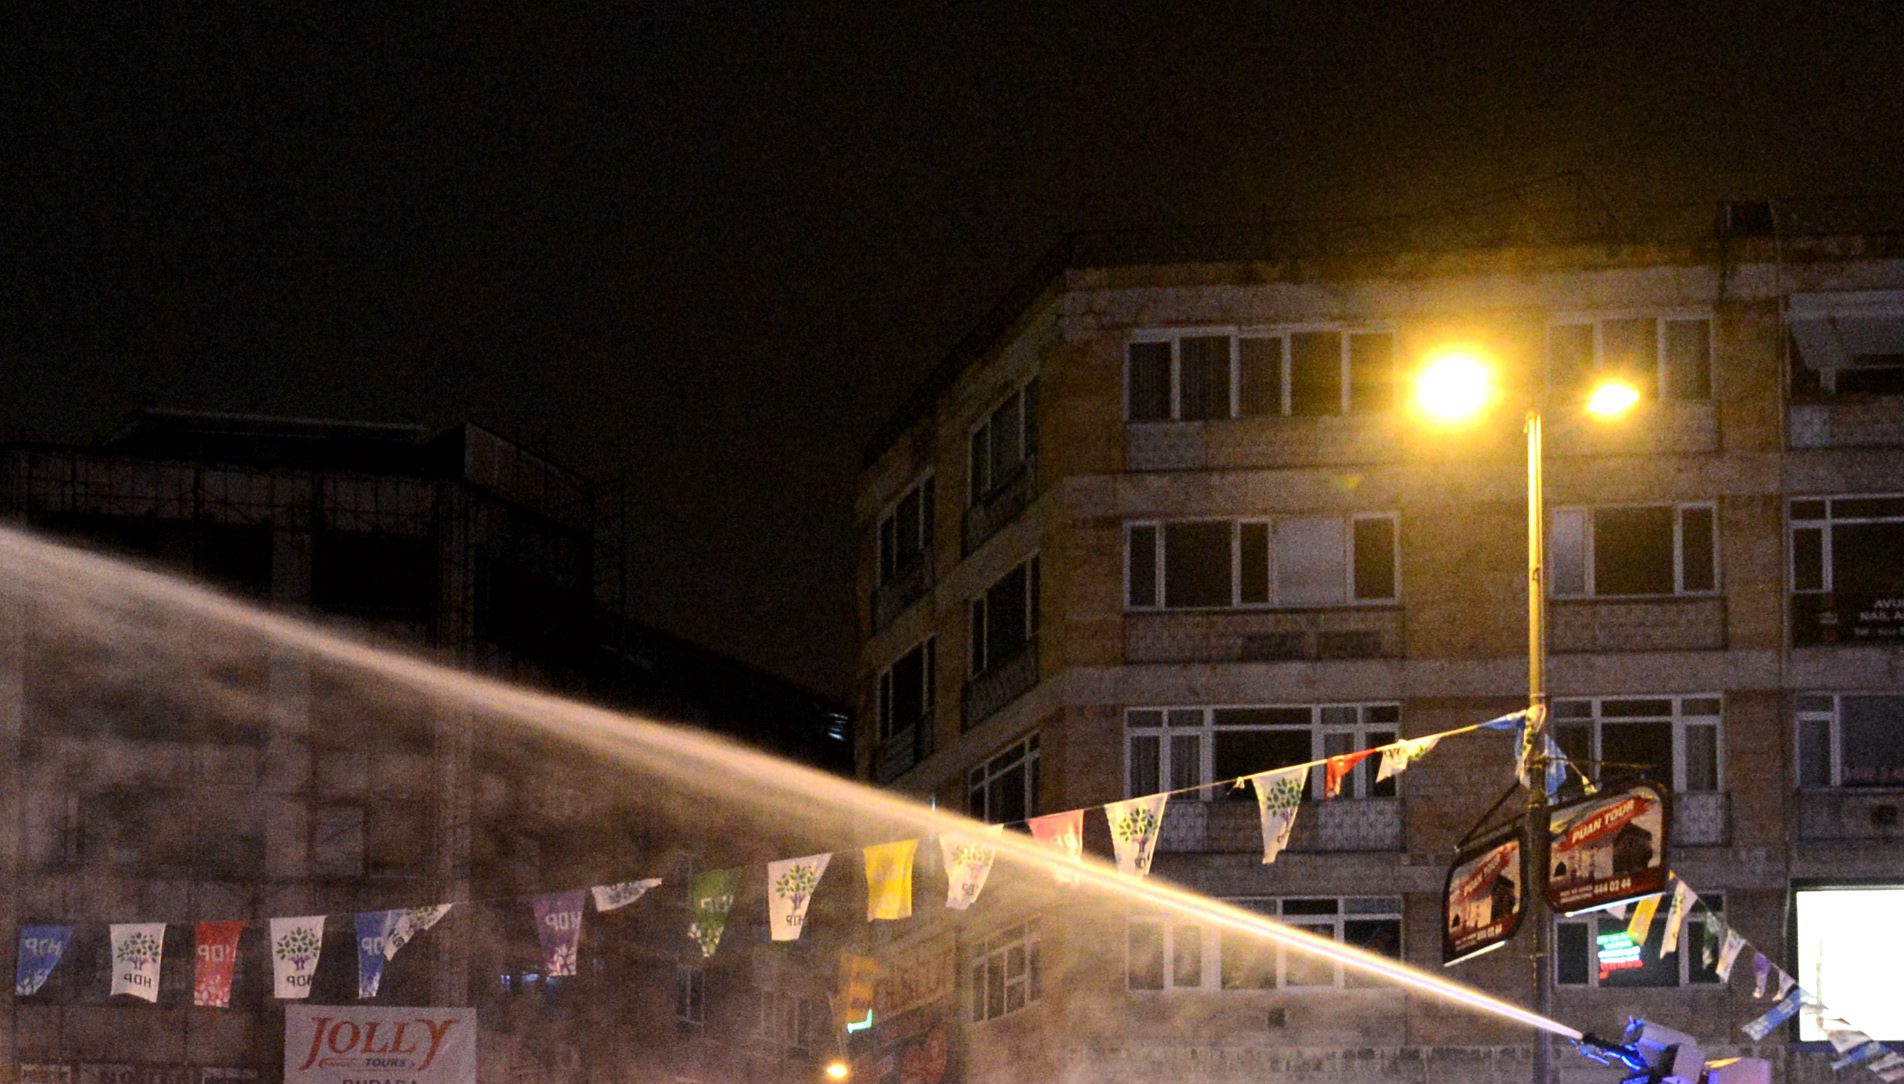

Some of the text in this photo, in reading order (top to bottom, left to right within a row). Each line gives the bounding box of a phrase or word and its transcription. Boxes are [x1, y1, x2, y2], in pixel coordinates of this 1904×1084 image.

[1572, 799, 1635, 843] PUAN TOUR
[1621, 878, 1632, 889] 44
[298, 1016, 460, 1071] JOLLY
[365, 1058, 406, 1068] TOURS
